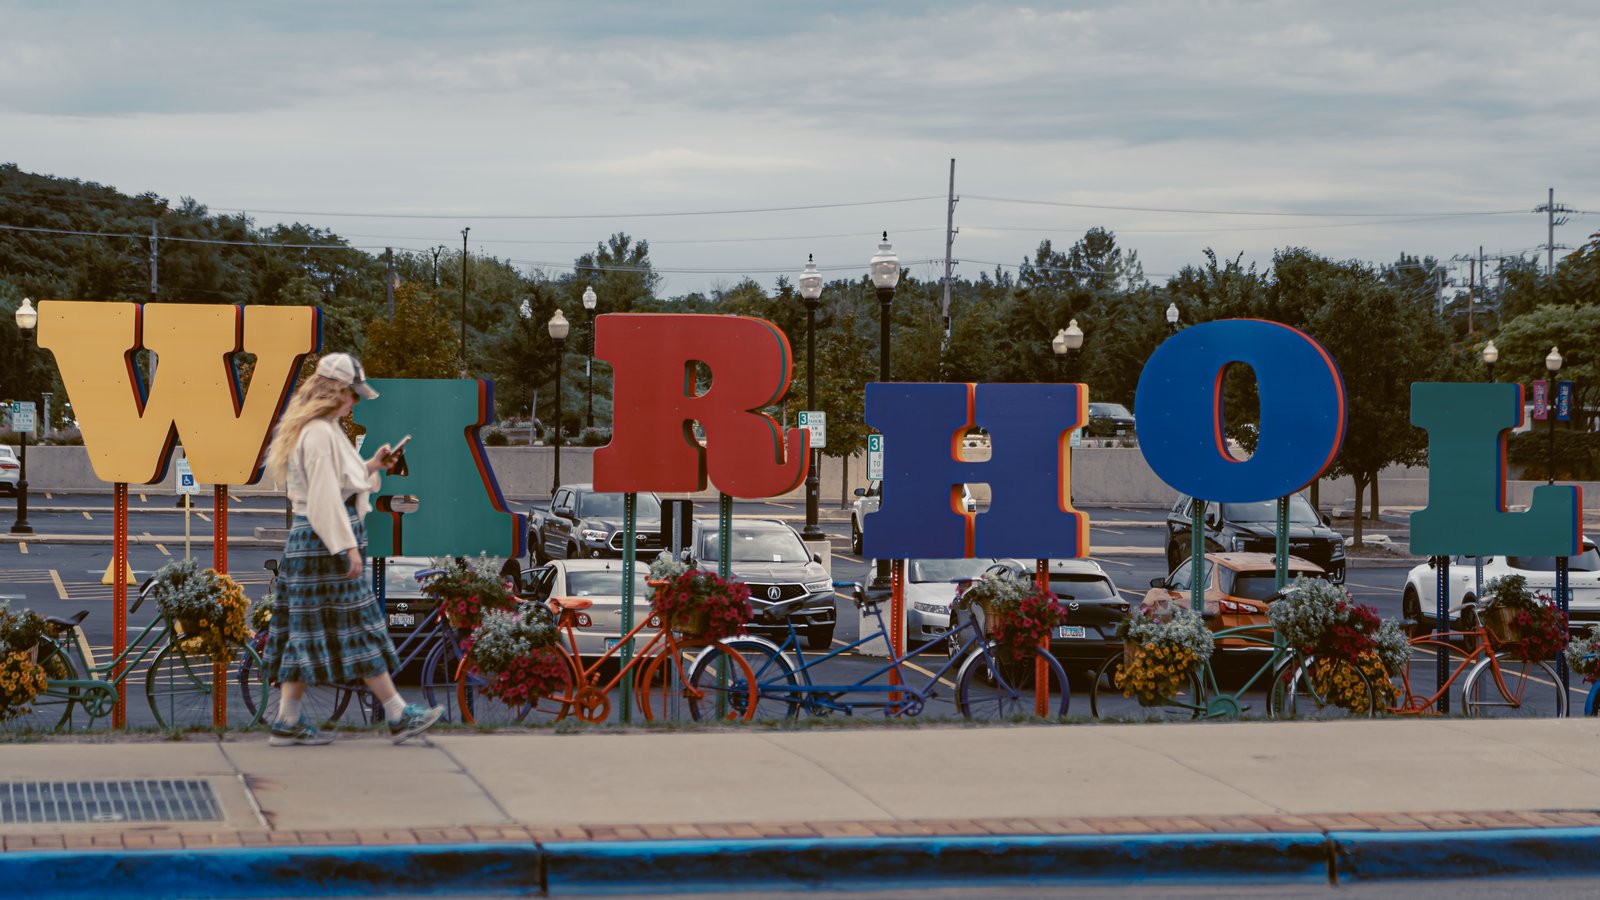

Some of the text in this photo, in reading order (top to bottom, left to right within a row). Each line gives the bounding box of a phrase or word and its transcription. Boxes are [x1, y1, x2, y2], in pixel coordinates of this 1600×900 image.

[14, 403, 20, 412] 3
[800, 413, 807, 424] 3
[37, 300, 1583, 559] WARHOL
[871, 438, 879, 450] 3
